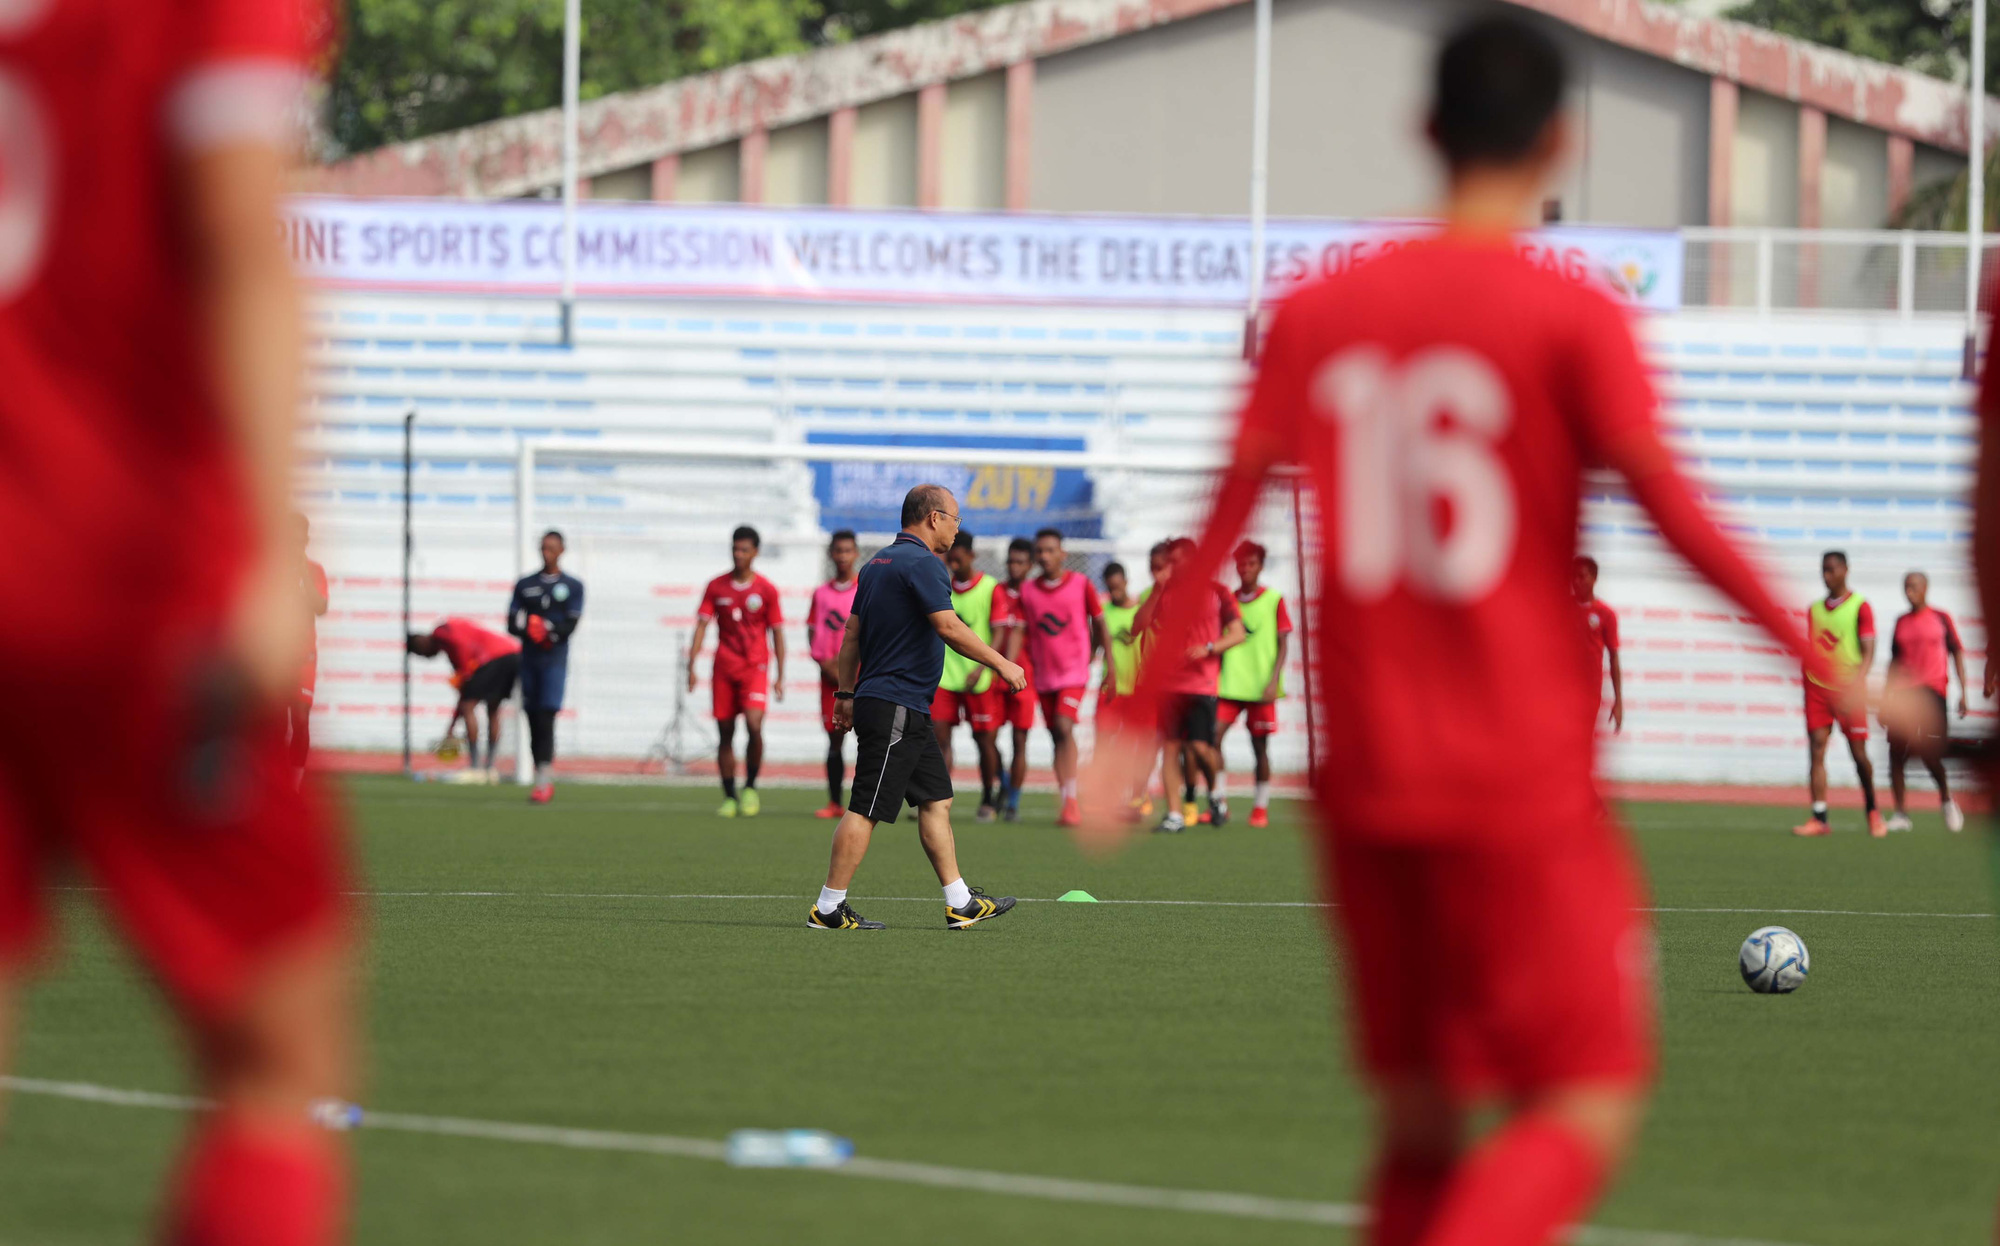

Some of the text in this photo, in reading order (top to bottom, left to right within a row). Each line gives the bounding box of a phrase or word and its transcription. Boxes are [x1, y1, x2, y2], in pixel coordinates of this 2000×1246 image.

[359, 222, 509, 270] SPORTS
[521, 223, 772, 271] COMMISSION
[787, 229, 1002, 279] WELCOMES
[1014, 236, 1082, 279] THE
[1308, 342, 1517, 605] 16
